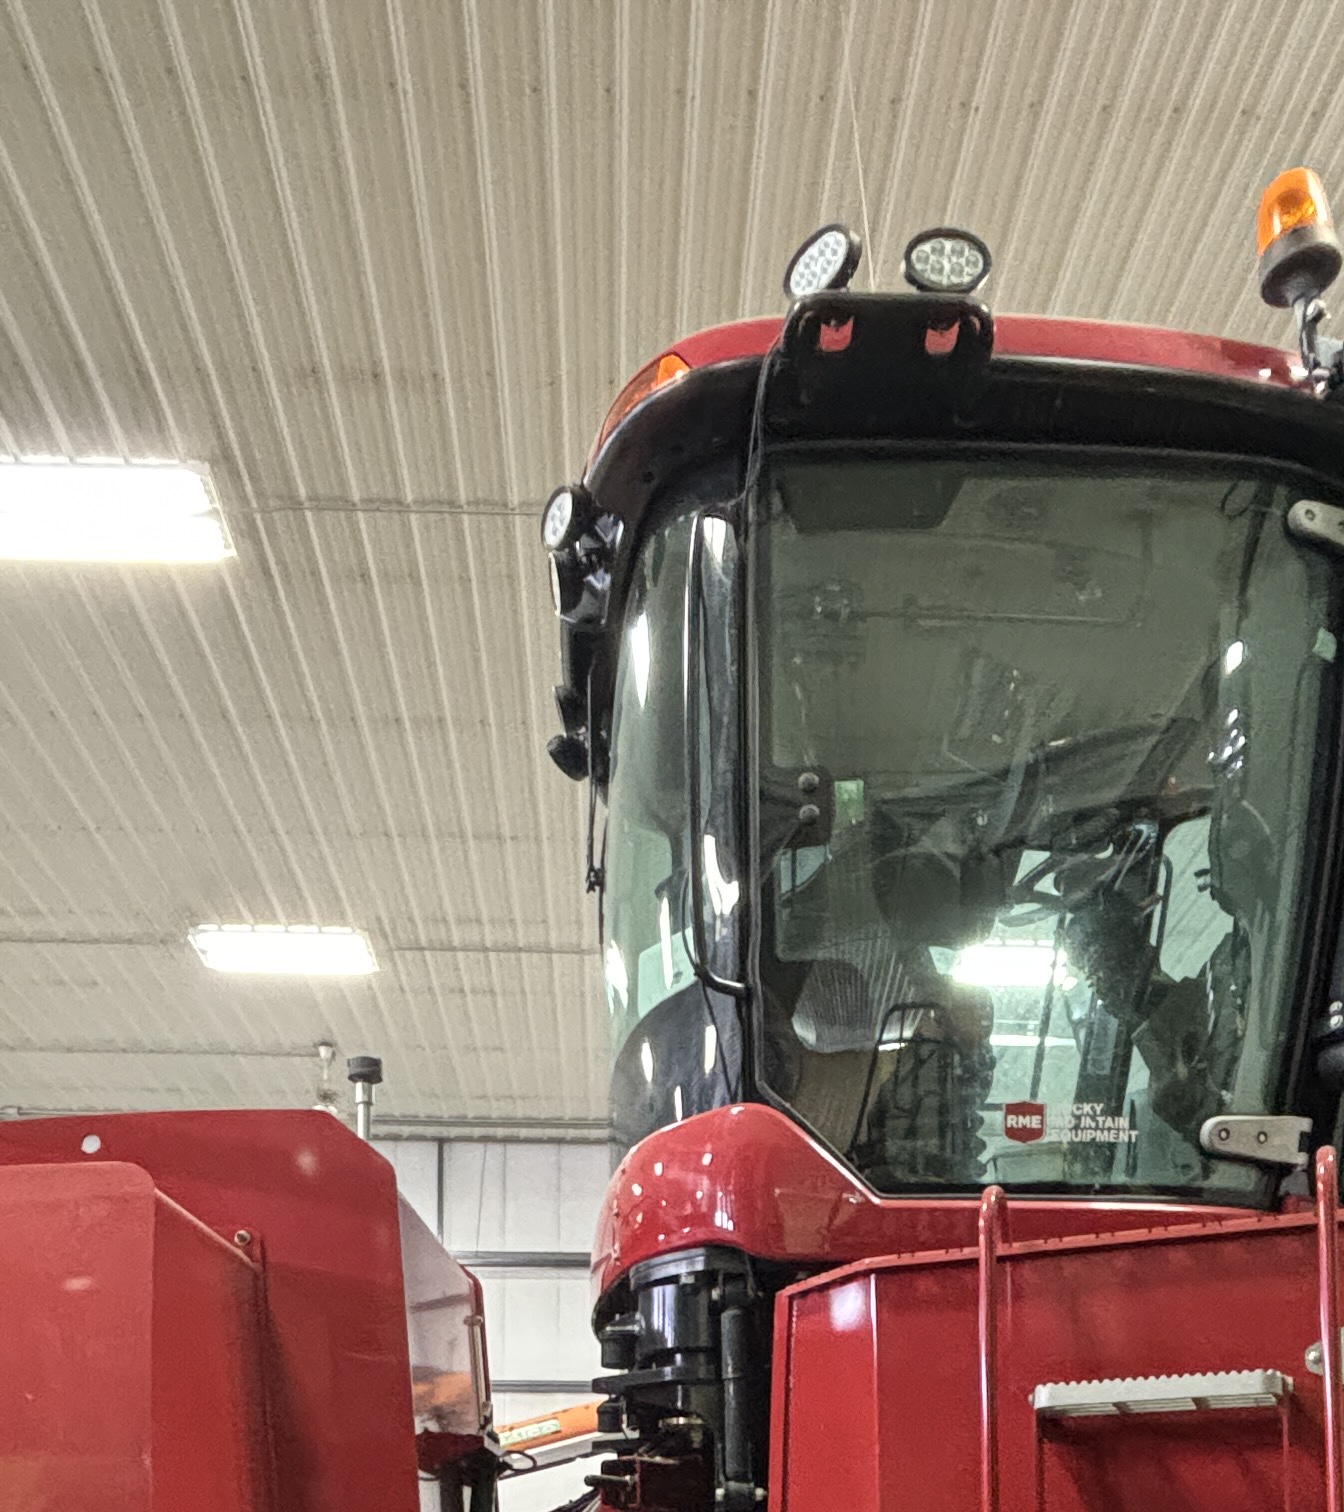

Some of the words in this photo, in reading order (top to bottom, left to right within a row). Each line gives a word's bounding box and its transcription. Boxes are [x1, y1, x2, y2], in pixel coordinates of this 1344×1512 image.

[1050, 1102, 1105, 1116] CKY
[1006, 1114, 1043, 1129] RME
[1050, 1129, 1139, 1143] EQUIPMENT
